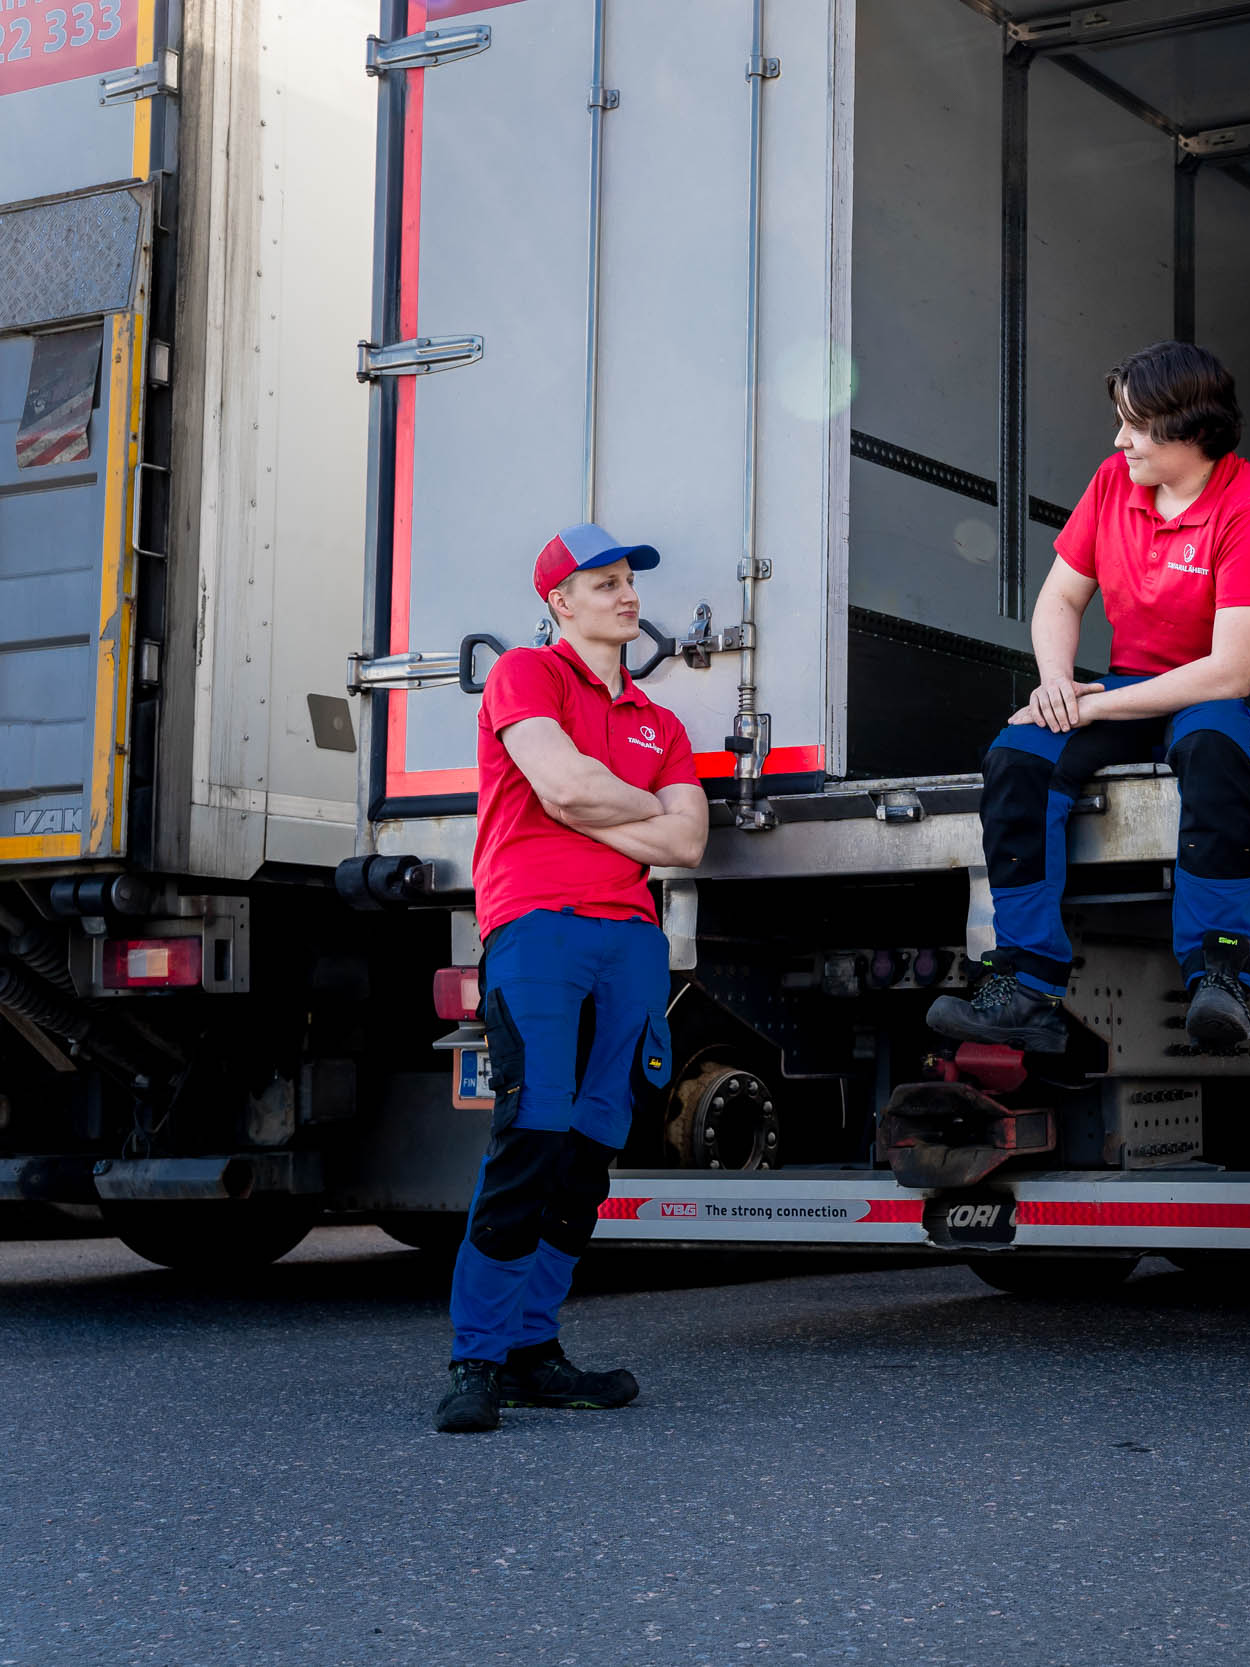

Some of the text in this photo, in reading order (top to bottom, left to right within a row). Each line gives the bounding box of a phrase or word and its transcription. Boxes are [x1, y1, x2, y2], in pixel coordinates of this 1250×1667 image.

[0, 0, 121, 64] 2 333
[14, 807, 83, 834] VAK
[463, 1078, 476, 1088] FIN
[661, 1203, 697, 1217] VBG
[705, 1204, 848, 1220] The strong connection
